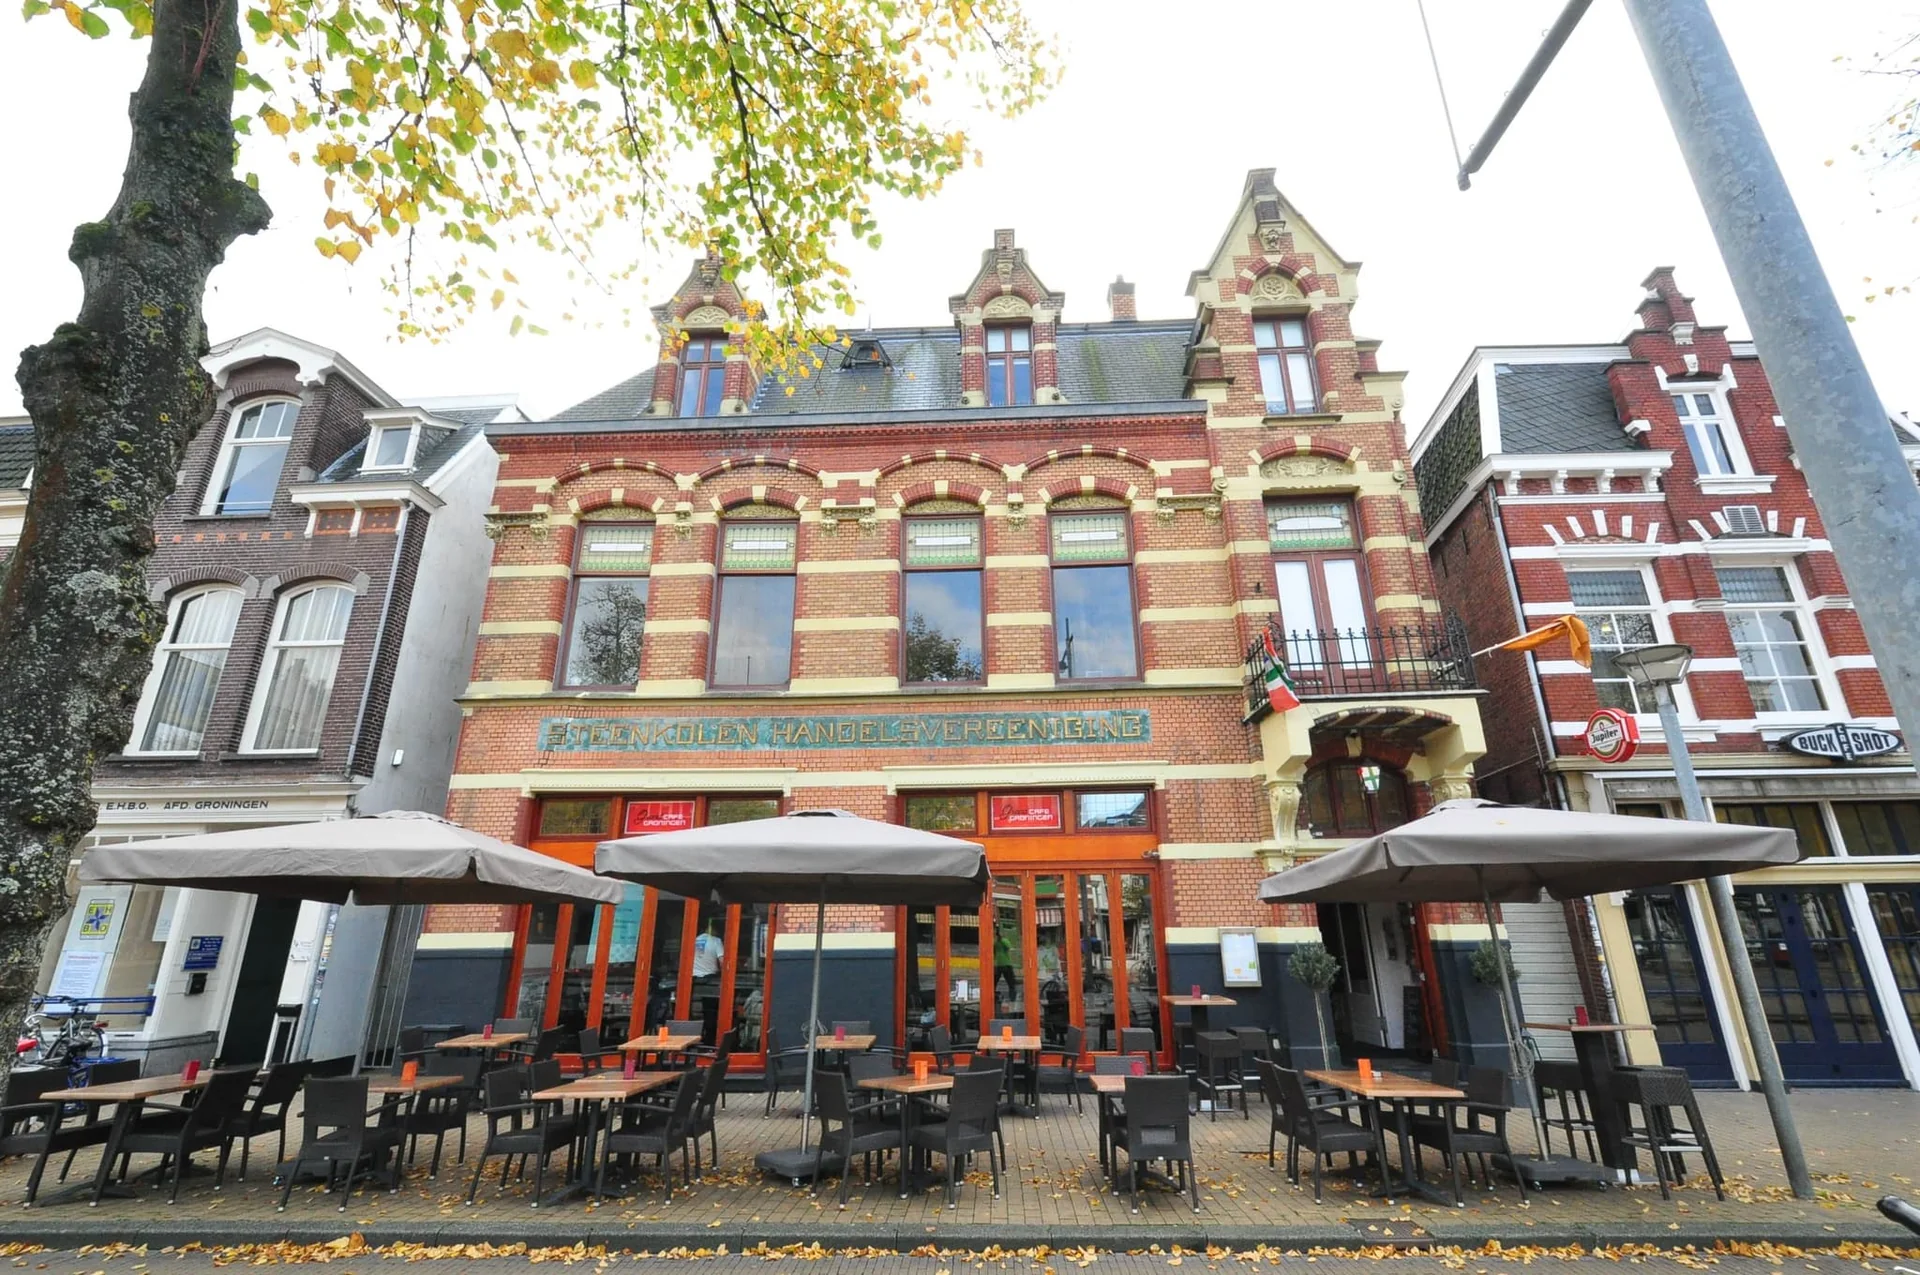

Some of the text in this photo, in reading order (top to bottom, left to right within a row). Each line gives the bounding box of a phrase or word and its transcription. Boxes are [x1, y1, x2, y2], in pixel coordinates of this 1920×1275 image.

[549, 715, 1141, 746] STEENKOLEN HANDELSVEREENIGING
[1591, 729, 1618, 744] Jupiler
[1798, 732, 1890, 753] BUCK SHOT
[163, 801, 191, 810] AFD.
[194, 800, 269, 810] GRONINGEN
